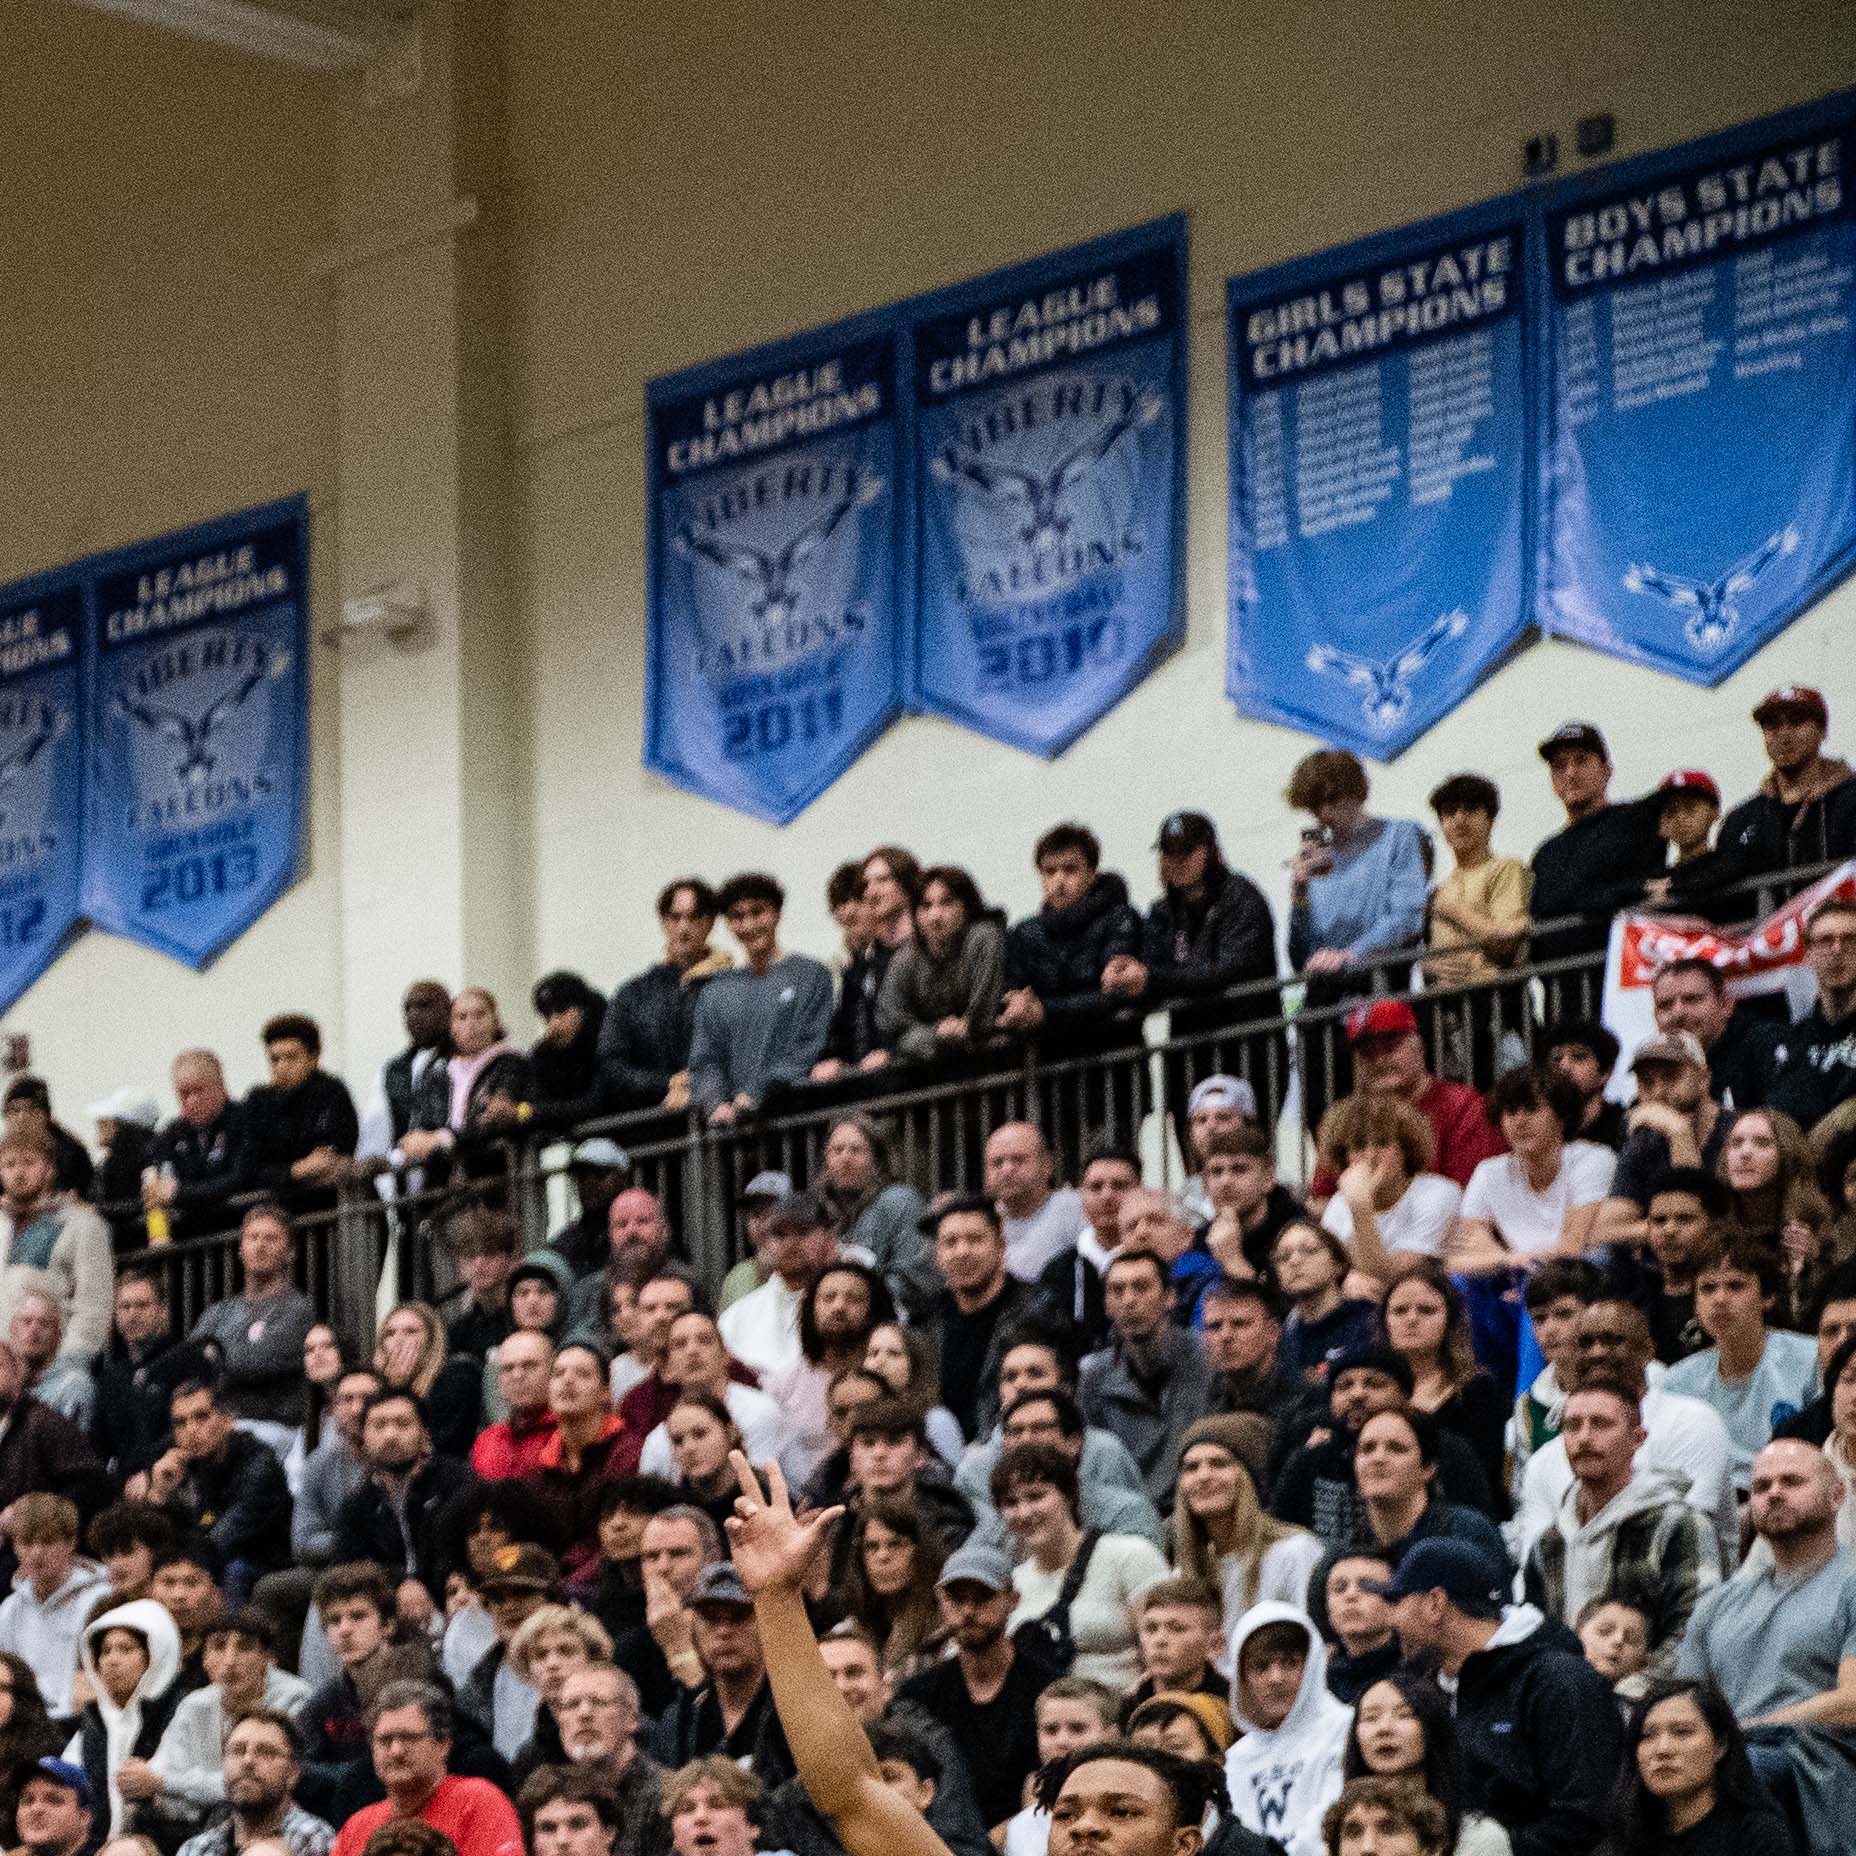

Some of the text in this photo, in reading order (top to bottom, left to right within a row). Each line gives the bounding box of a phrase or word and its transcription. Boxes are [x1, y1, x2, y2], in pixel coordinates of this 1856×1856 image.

[1562, 137, 1843, 251] BOYS STATE
[1564, 176, 1844, 286] CHAMPIONS
[966, 273, 1119, 348] LEAGUE
[1246, 237, 1512, 345] GIRLS STATE
[1251, 273, 1507, 379] CHAMPIONS
[928, 294, 1162, 395] CHAMPIONS
[667, 381, 881, 474] CHAMPIONS
[703, 358, 843, 429] LEAGUE
[106, 567, 286, 642] CHAMPIONS
[137, 544, 256, 602] LEAGUE
